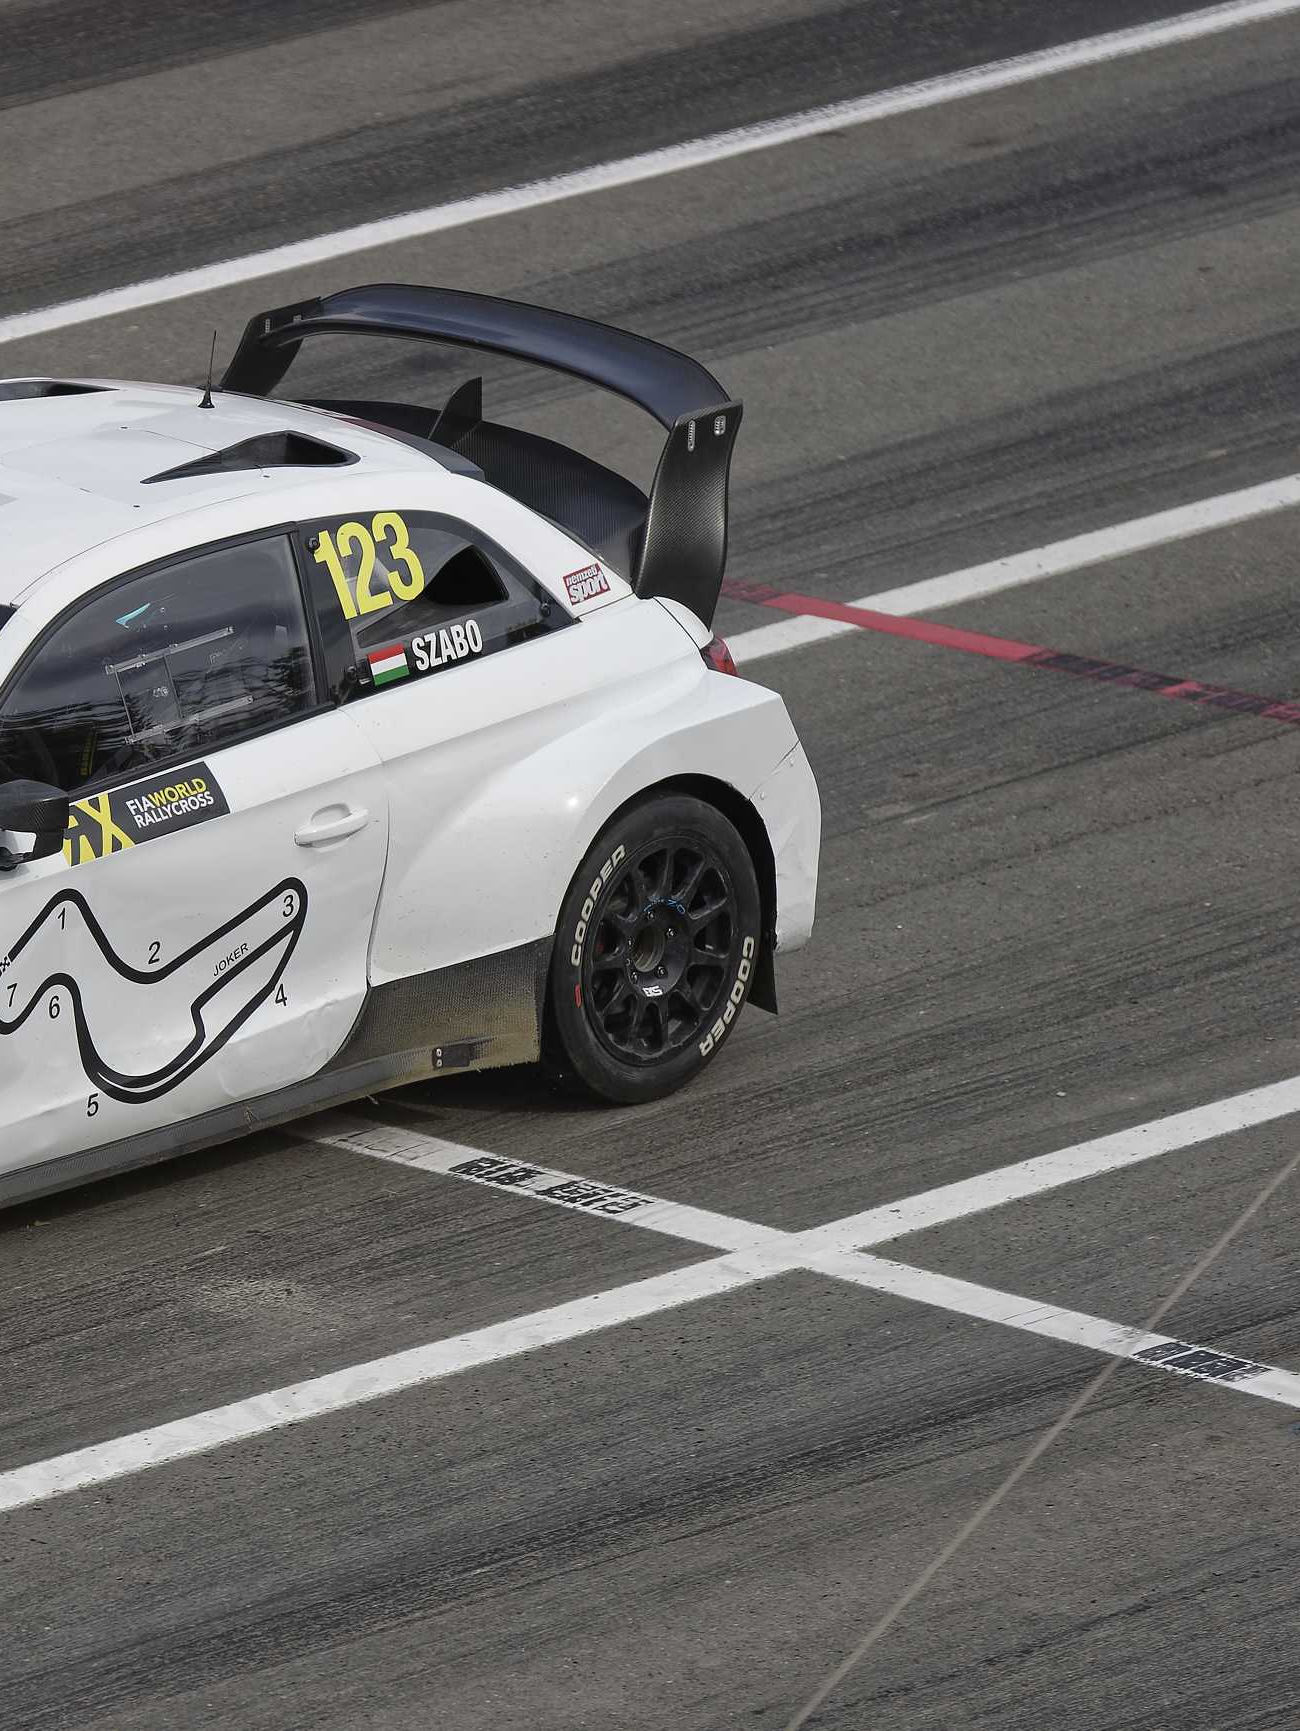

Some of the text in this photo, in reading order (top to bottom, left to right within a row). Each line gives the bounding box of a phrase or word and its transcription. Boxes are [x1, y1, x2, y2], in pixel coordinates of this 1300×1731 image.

[313, 512, 425, 620] 123
[411, 619, 484, 671] SZABO
[133, 791, 215, 830] RALLYCROSS
[57, 907, 67, 930] 1
[281, 894, 294, 918] 3
[571, 844, 626, 967] COOPER
[147, 940, 162, 965] 2
[213, 941, 250, 977] JOKER
[6, 982, 18, 1008] 7
[47, 996, 62, 1020] 6
[273, 984, 288, 1007] 4
[700, 936, 755, 1057] COOPER
[86, 1094, 100, 1118] 5
